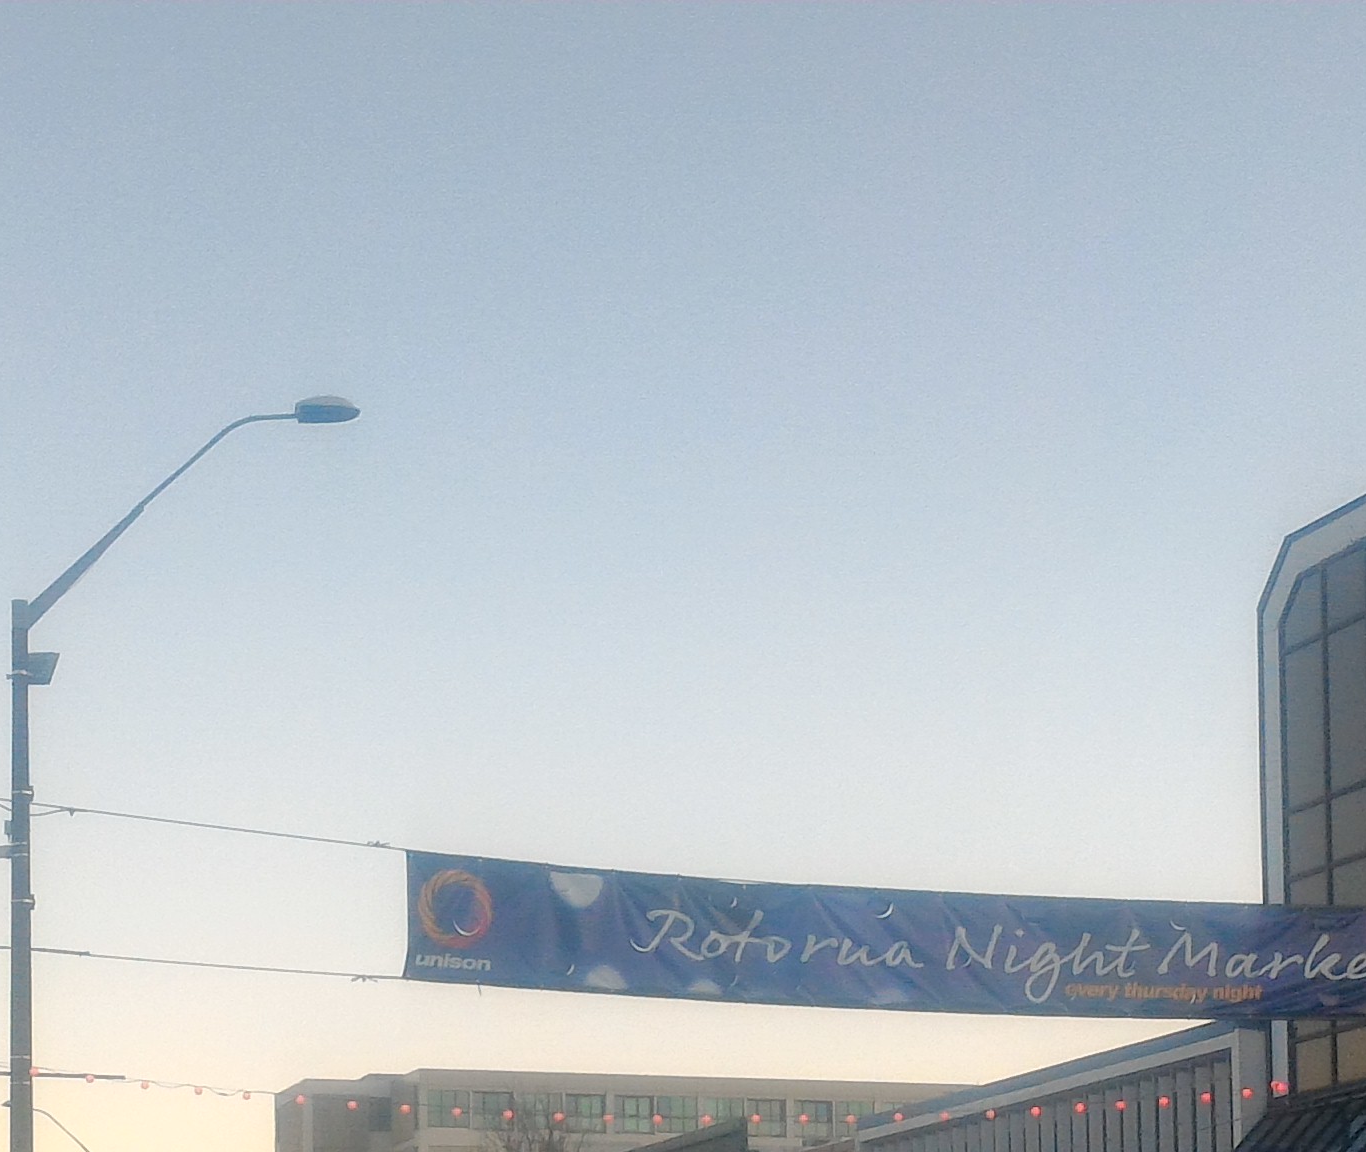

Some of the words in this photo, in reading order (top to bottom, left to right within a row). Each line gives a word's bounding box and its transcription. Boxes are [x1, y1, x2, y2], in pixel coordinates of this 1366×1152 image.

[415, 953, 492, 971] unison
[628, 908, 924, 968] Rotorua
[946, 923, 1151, 1003] Night
[1065, 982, 1119, 1000] every
[1124, 983, 1208, 1004] thursday
[1213, 984, 1264, 1002] night
